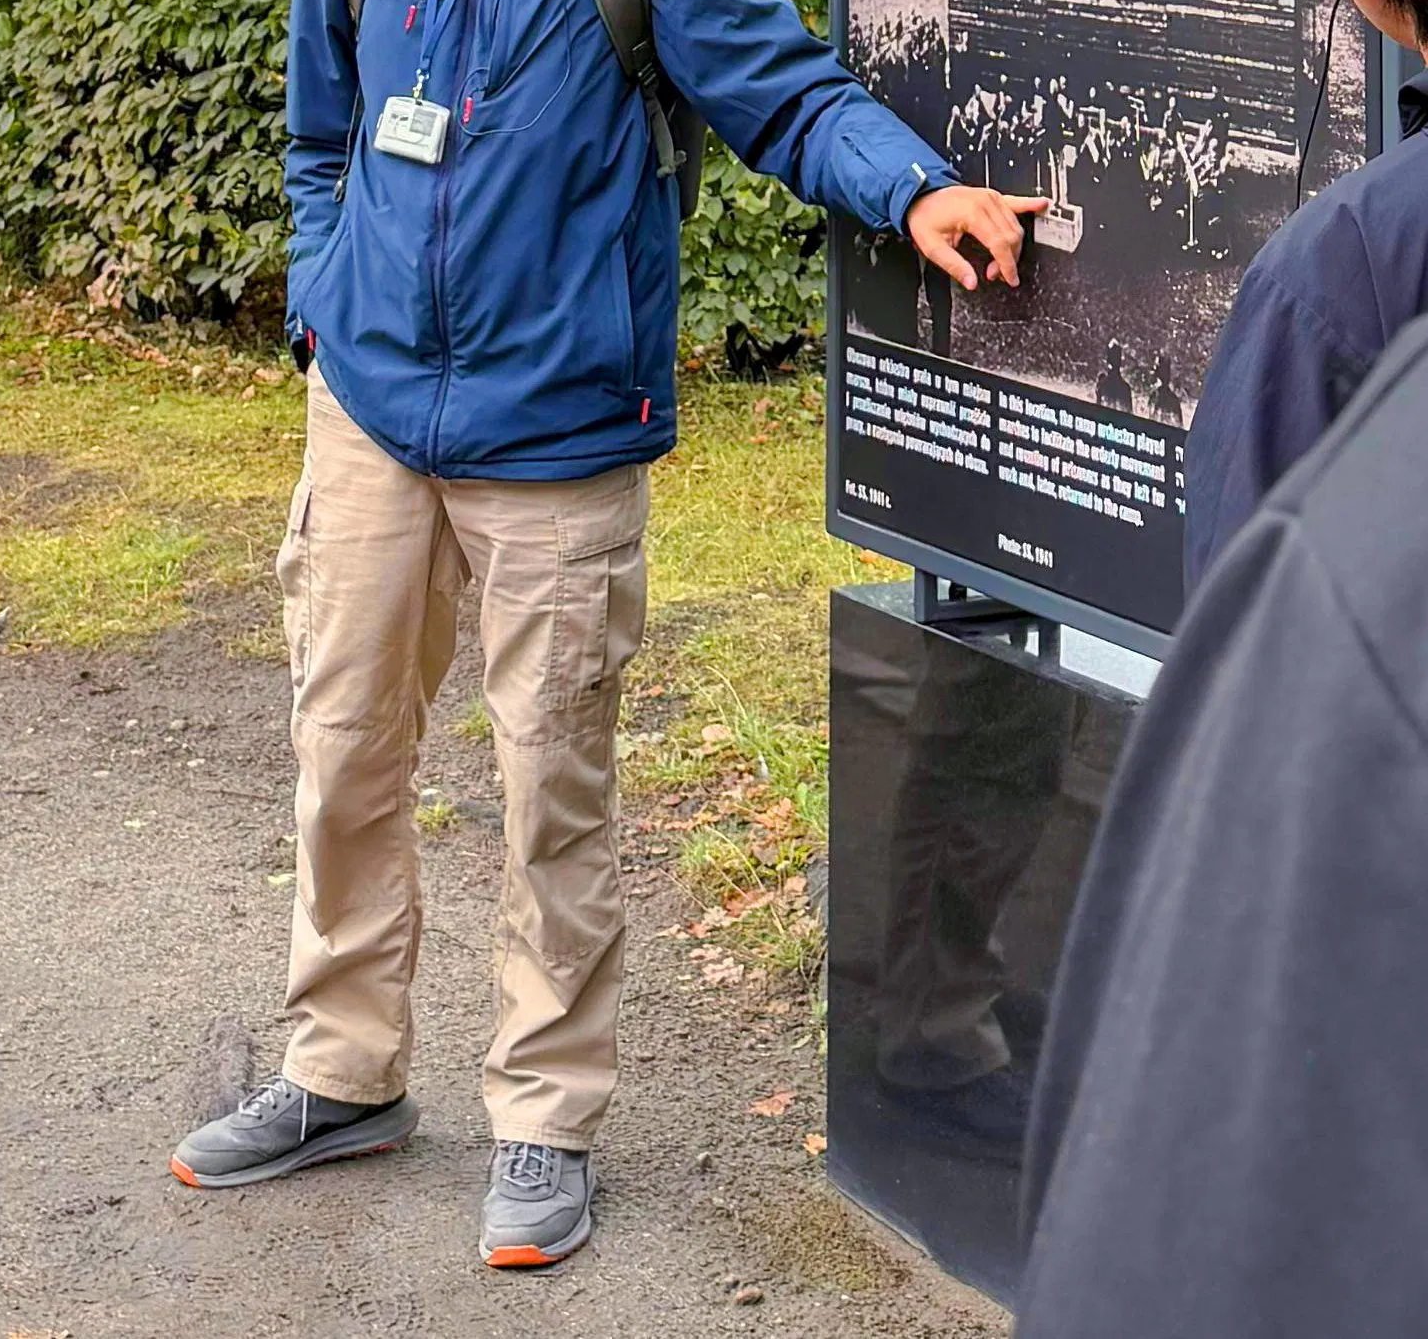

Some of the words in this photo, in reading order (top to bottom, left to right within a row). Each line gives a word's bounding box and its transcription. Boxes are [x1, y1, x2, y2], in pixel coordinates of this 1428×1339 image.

[1008, 395, 1023, 413] this
[1025, 399, 1057, 425] location,
[1060, 409, 1073, 428] the
[1098, 422, 1135, 447] orchestra
[1137, 432, 1165, 457] played
[1076, 438, 1090, 457] the
[1051, 456, 1060, 473] of
[1112, 476, 1132, 499] they
[1134, 481, 1149, 502] left
[1104, 498, 1118, 518] the
